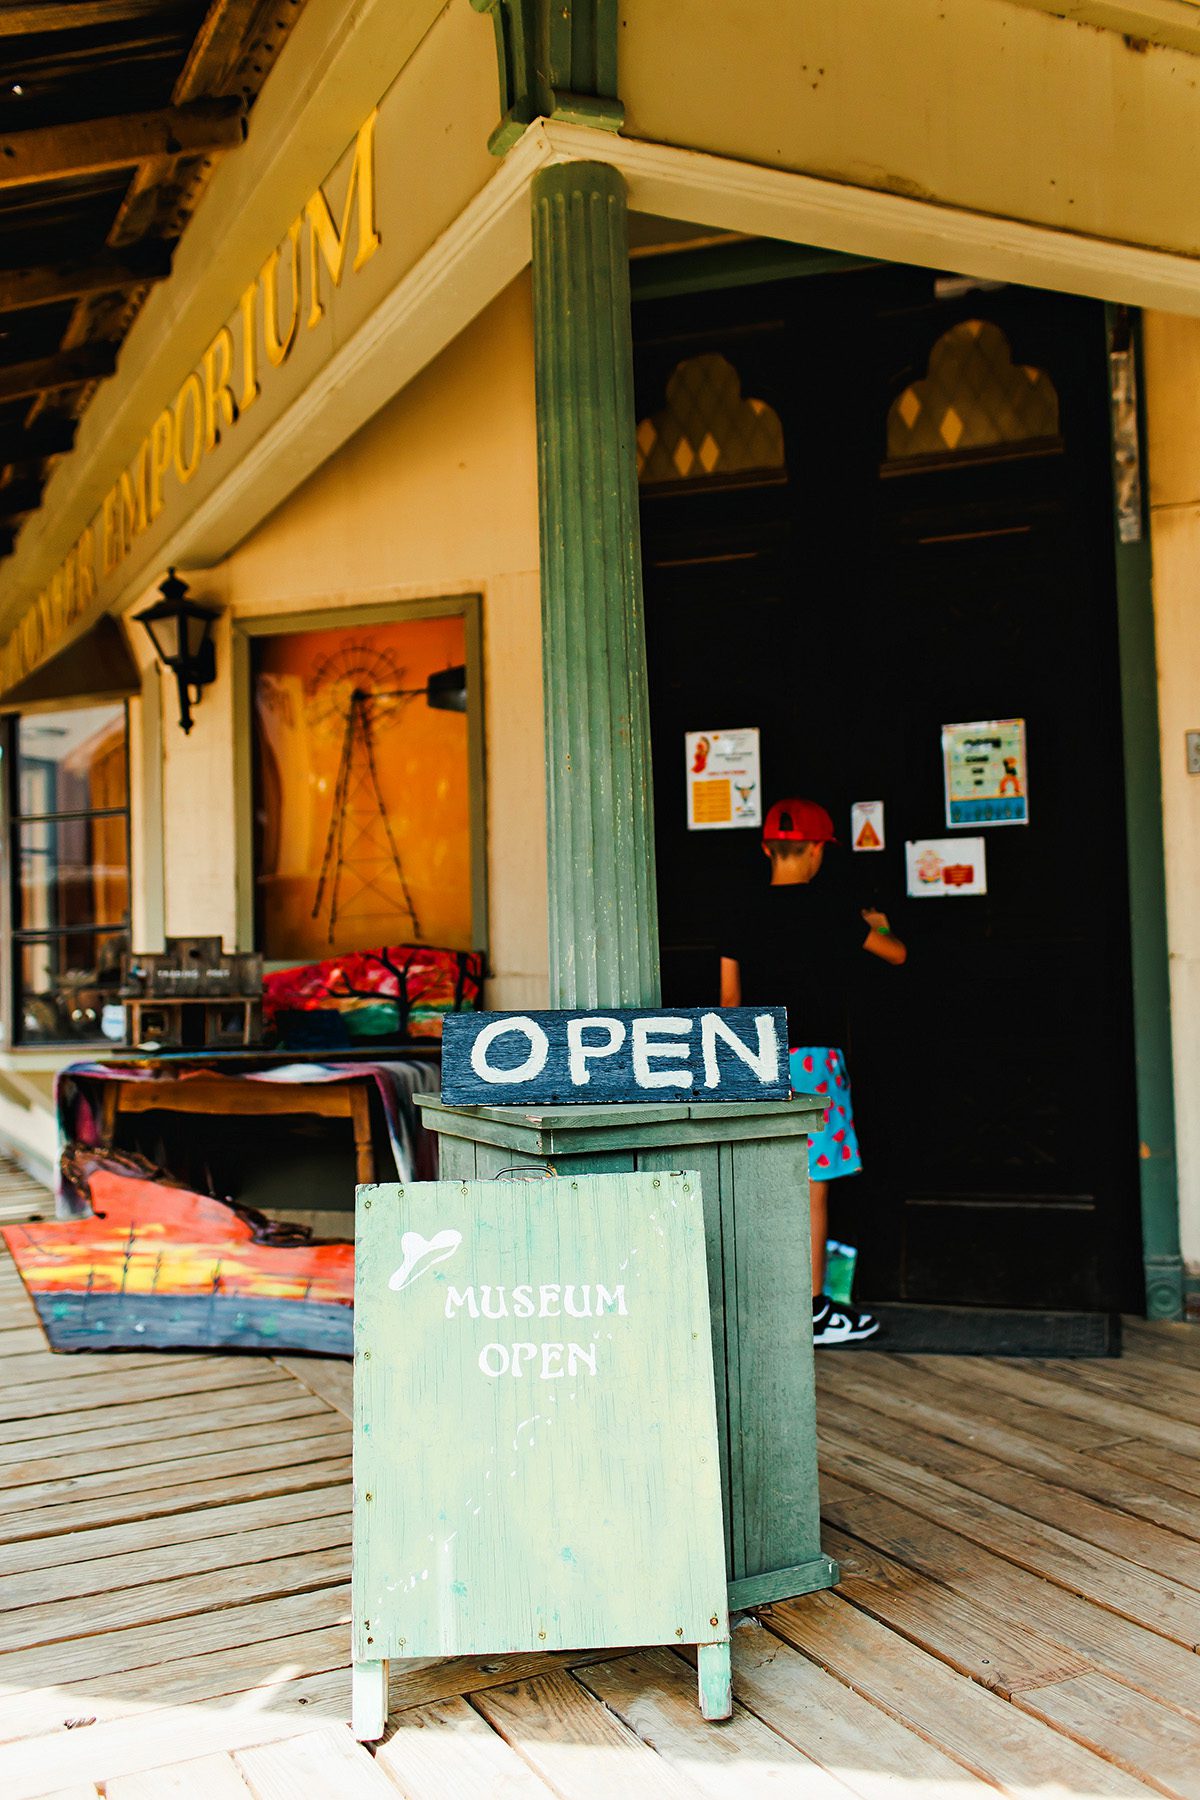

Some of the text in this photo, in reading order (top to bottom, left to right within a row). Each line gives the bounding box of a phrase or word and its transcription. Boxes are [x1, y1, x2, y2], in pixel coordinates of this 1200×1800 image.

[102, 105, 382, 576] EMPORIUM
[471, 1012, 779, 1089] OPEN
[444, 1283, 629, 1319] MUSEUM
[478, 1342, 598, 1380] OPEN
